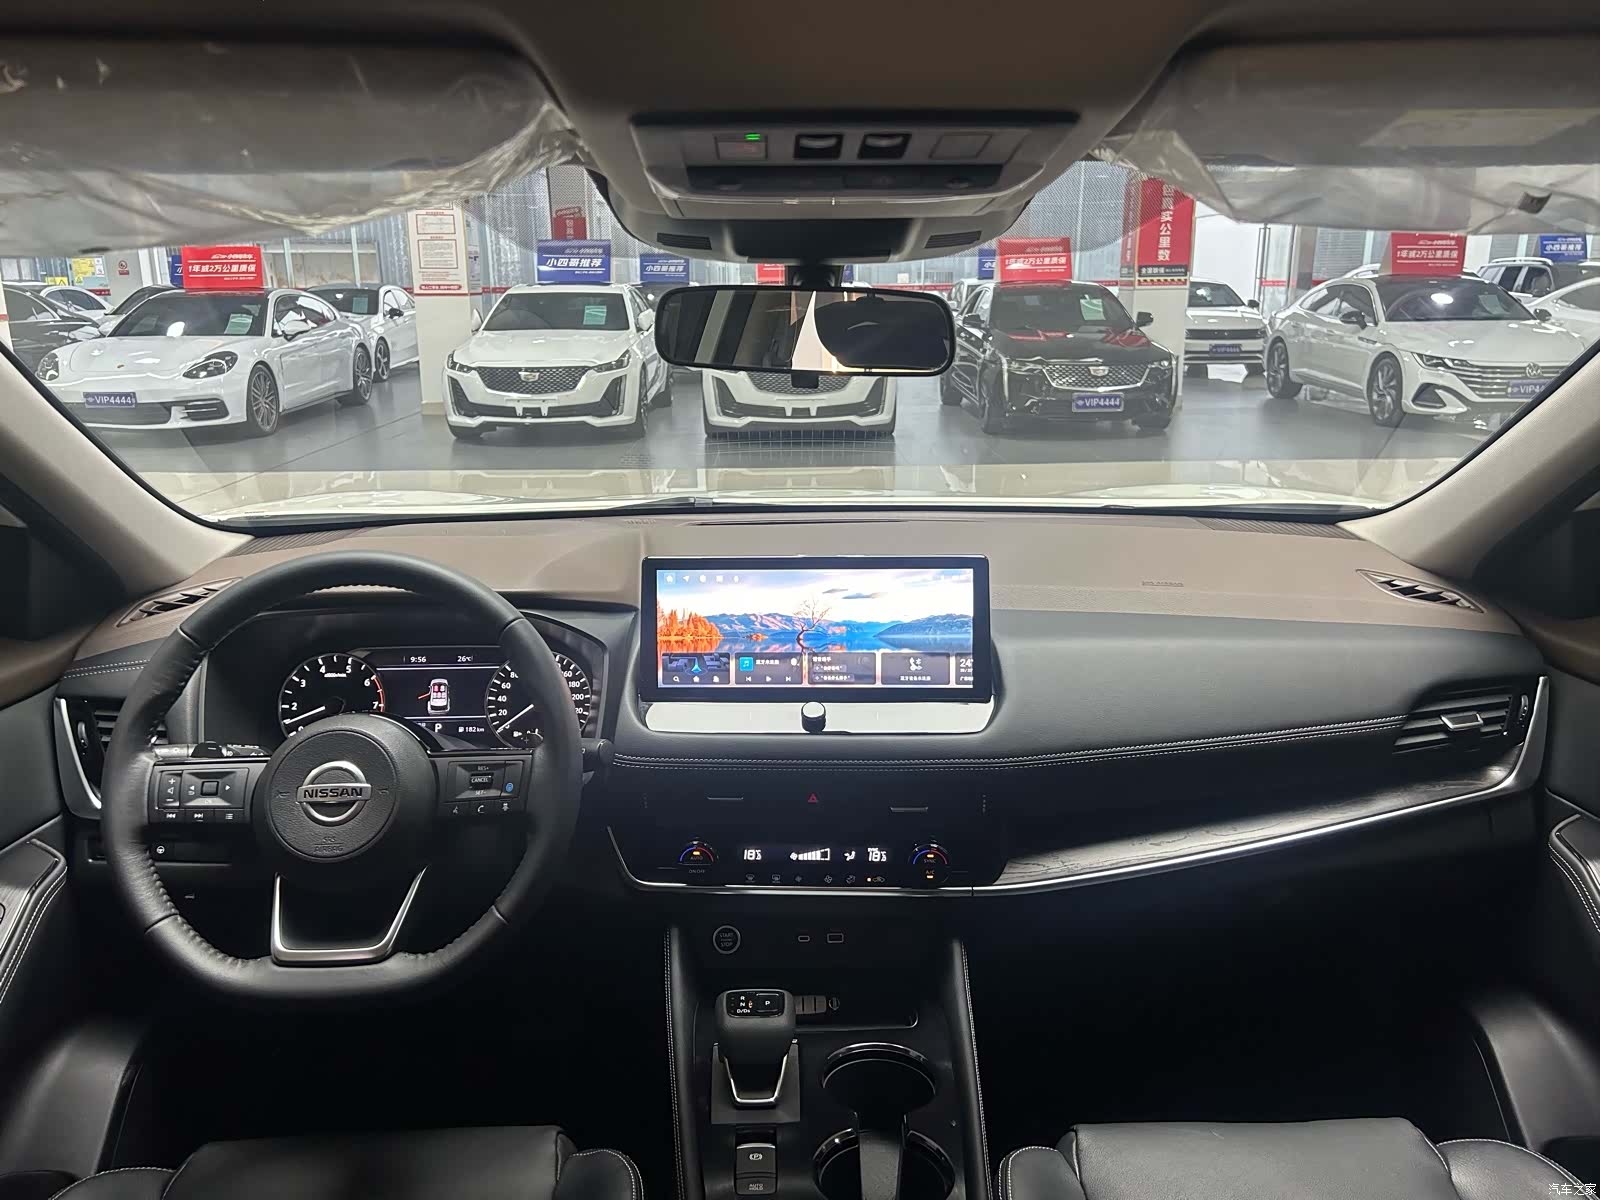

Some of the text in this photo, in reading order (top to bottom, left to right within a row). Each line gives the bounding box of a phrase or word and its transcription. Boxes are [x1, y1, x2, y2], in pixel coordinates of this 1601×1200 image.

[546, 258, 603, 267] 小四哥推荐
[94, 395, 132, 405] VIP4444
[1084, 397, 1120, 407] VIP4444
[319, 665, 326, 674] 4
[345, 665, 352, 674] 5
[300, 679, 307, 688] 3
[363, 678, 371, 687] 6
[501, 682, 512, 690] 60
[497, 695, 508, 703] 40
[571, 693, 585, 701] 200
[291, 702, 298, 711] 2
[372, 701, 379, 710] 7
[434, 723, 443, 733] P
[303, 787, 363, 800] NISSAN
